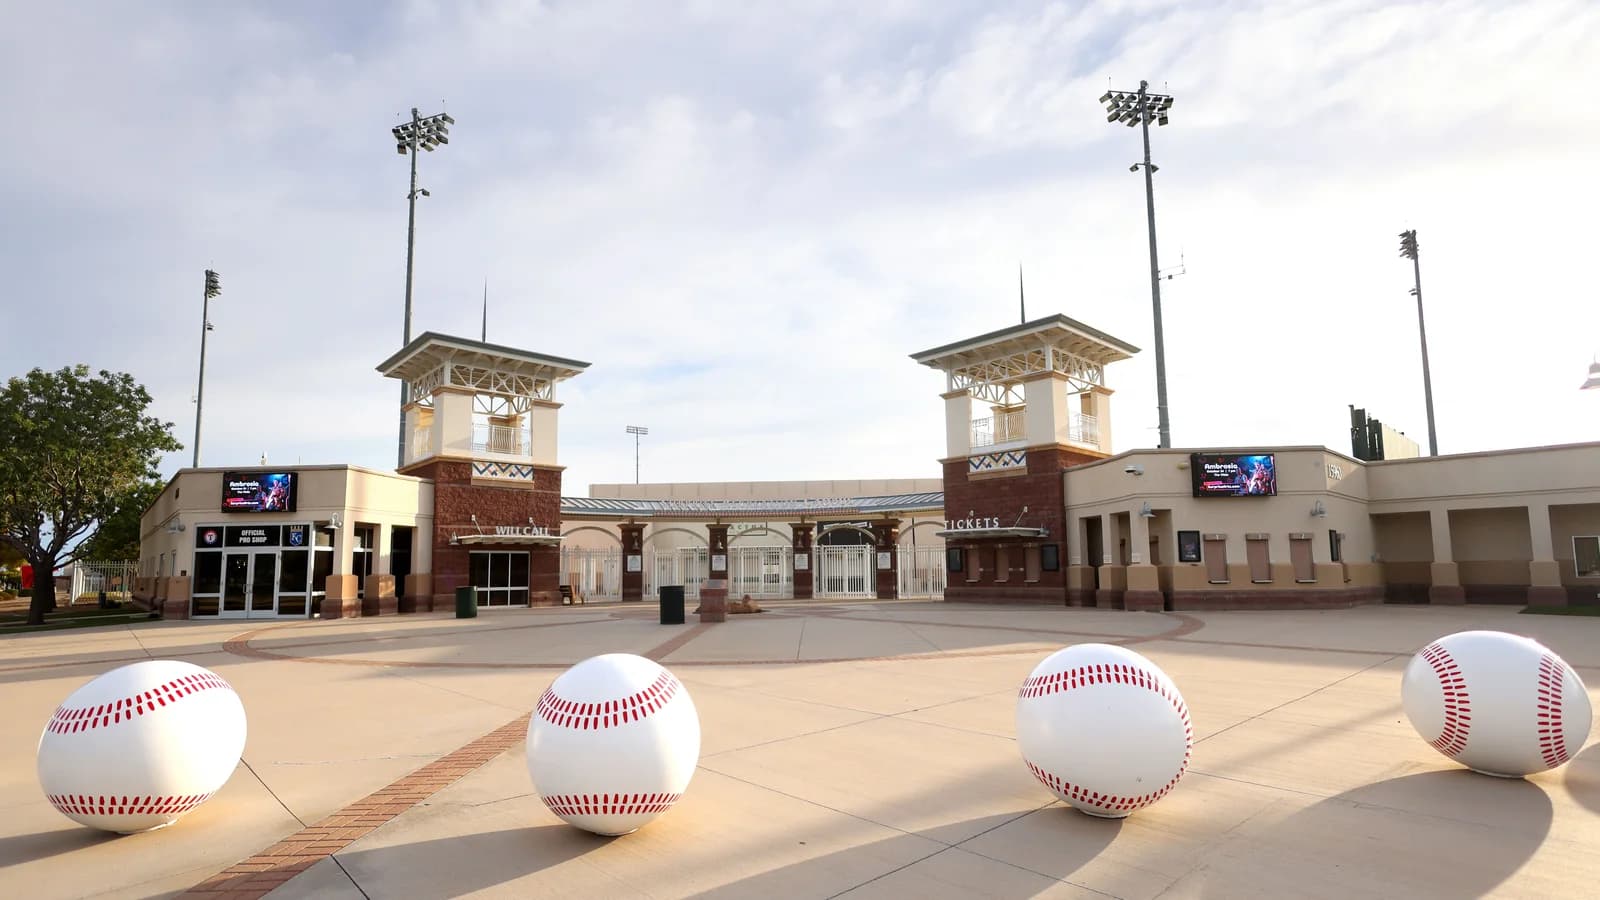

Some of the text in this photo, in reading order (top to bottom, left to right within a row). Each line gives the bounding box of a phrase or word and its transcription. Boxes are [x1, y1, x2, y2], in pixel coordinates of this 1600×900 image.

[1204, 462, 1238, 470] Ambrosia
[944, 517, 999, 530] TICKETS
[495, 525, 550, 536] WILL CALL
